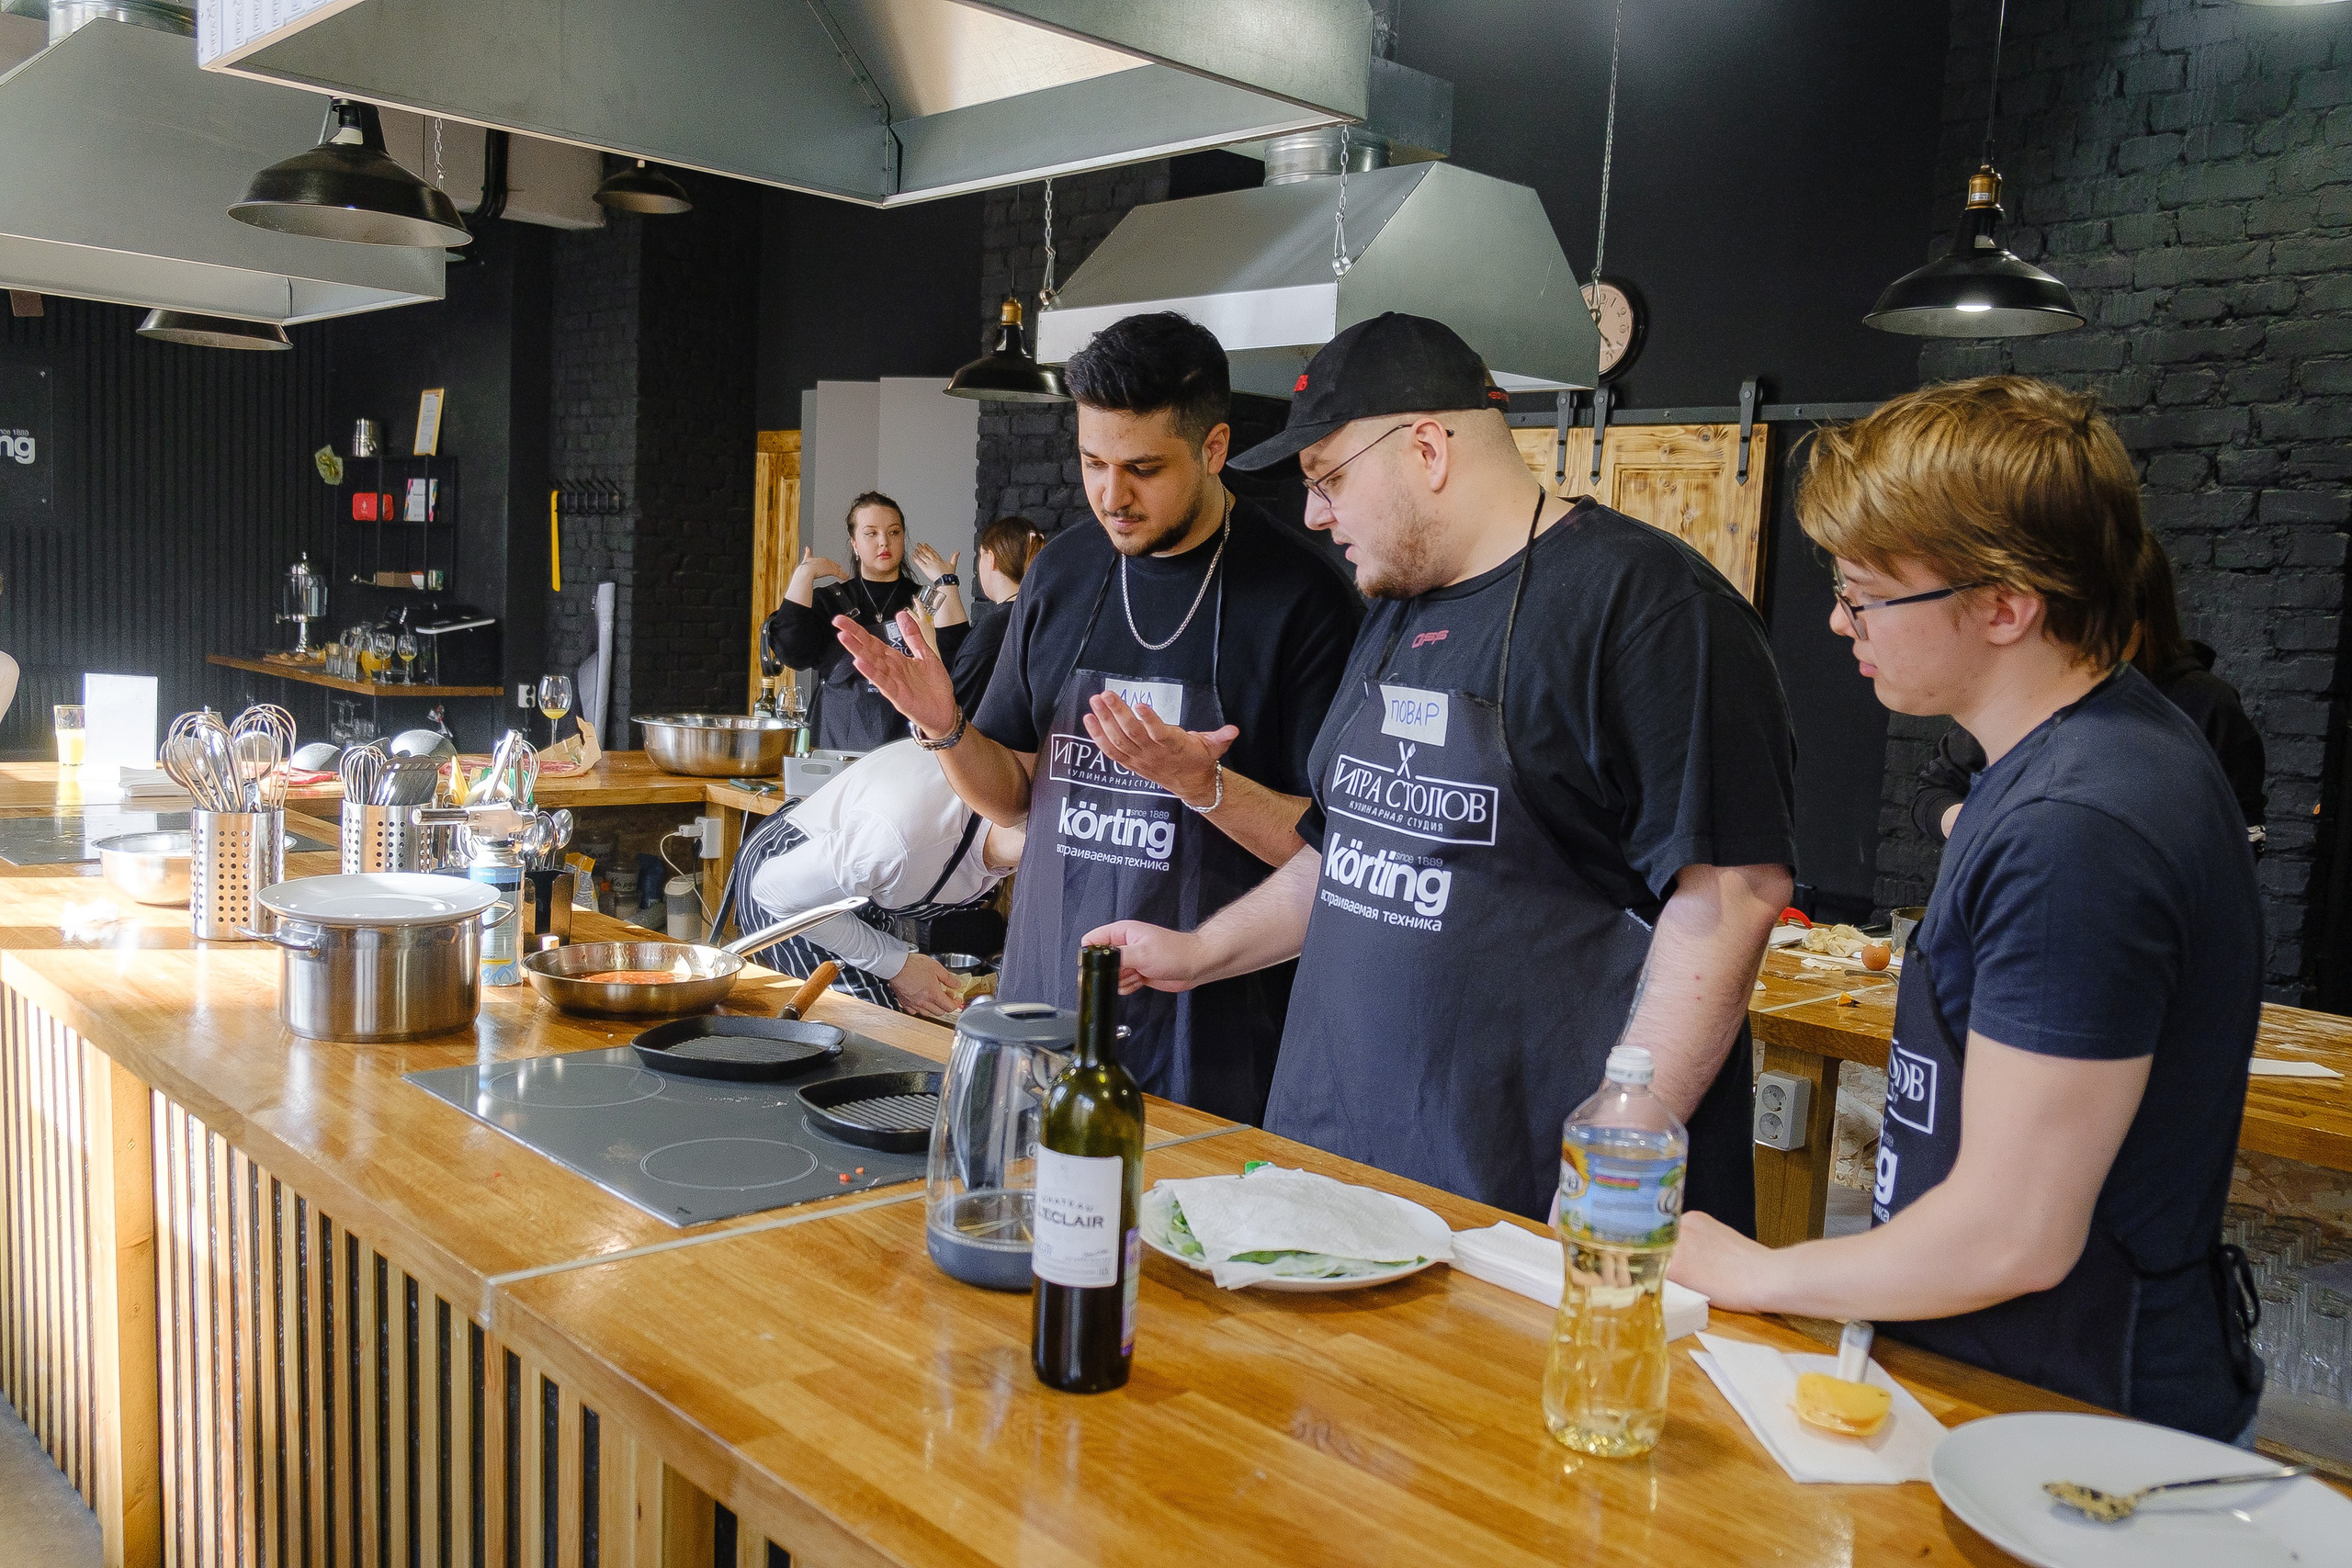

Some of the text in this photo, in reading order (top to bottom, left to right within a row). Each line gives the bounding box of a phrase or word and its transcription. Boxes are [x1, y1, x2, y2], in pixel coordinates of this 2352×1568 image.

[1391, 699, 1440, 727] ПОВАР
[1054, 739, 1107, 773] ИГРА
[1134, 780, 1165, 790] СТУДИ
[1331, 763, 1487, 824] ИГРА СТОЛОВ
[1057, 797, 1176, 860] körting
[1130, 809, 1170, 820] since 1889
[1349, 800, 1444, 833] КУЛИНАРНАЯ СТУДИЯ
[1056, 843, 1170, 872] встраиваемая техника
[1396, 852, 1443, 867] since 1889
[1326, 832, 1453, 917] körting
[1319, 889, 1442, 932] встраиваемая техника
